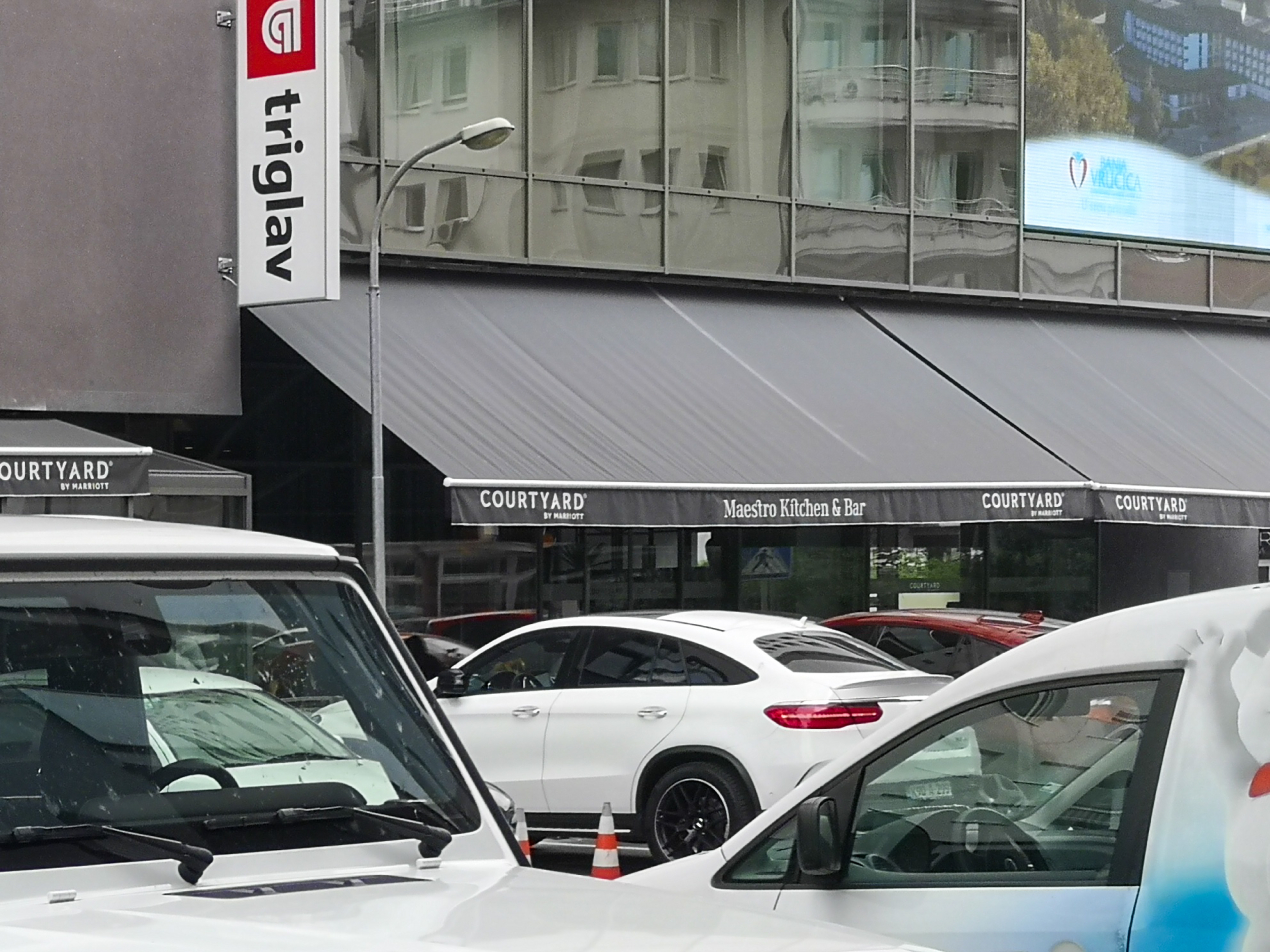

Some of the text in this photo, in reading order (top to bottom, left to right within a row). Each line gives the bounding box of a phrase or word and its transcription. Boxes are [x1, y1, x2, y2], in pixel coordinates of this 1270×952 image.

[252, 88, 304, 283] triglav
[60, 482, 109, 491] BY MARRIOTT
[480, 489, 585, 511] COURTYARD
[723, 498, 866, 518] Maestro Kitchen & Bar
[982, 492, 1063, 509] COURTYARD
[1115, 495, 1187, 512] COURTYARD
[543, 511, 552, 520] BY
